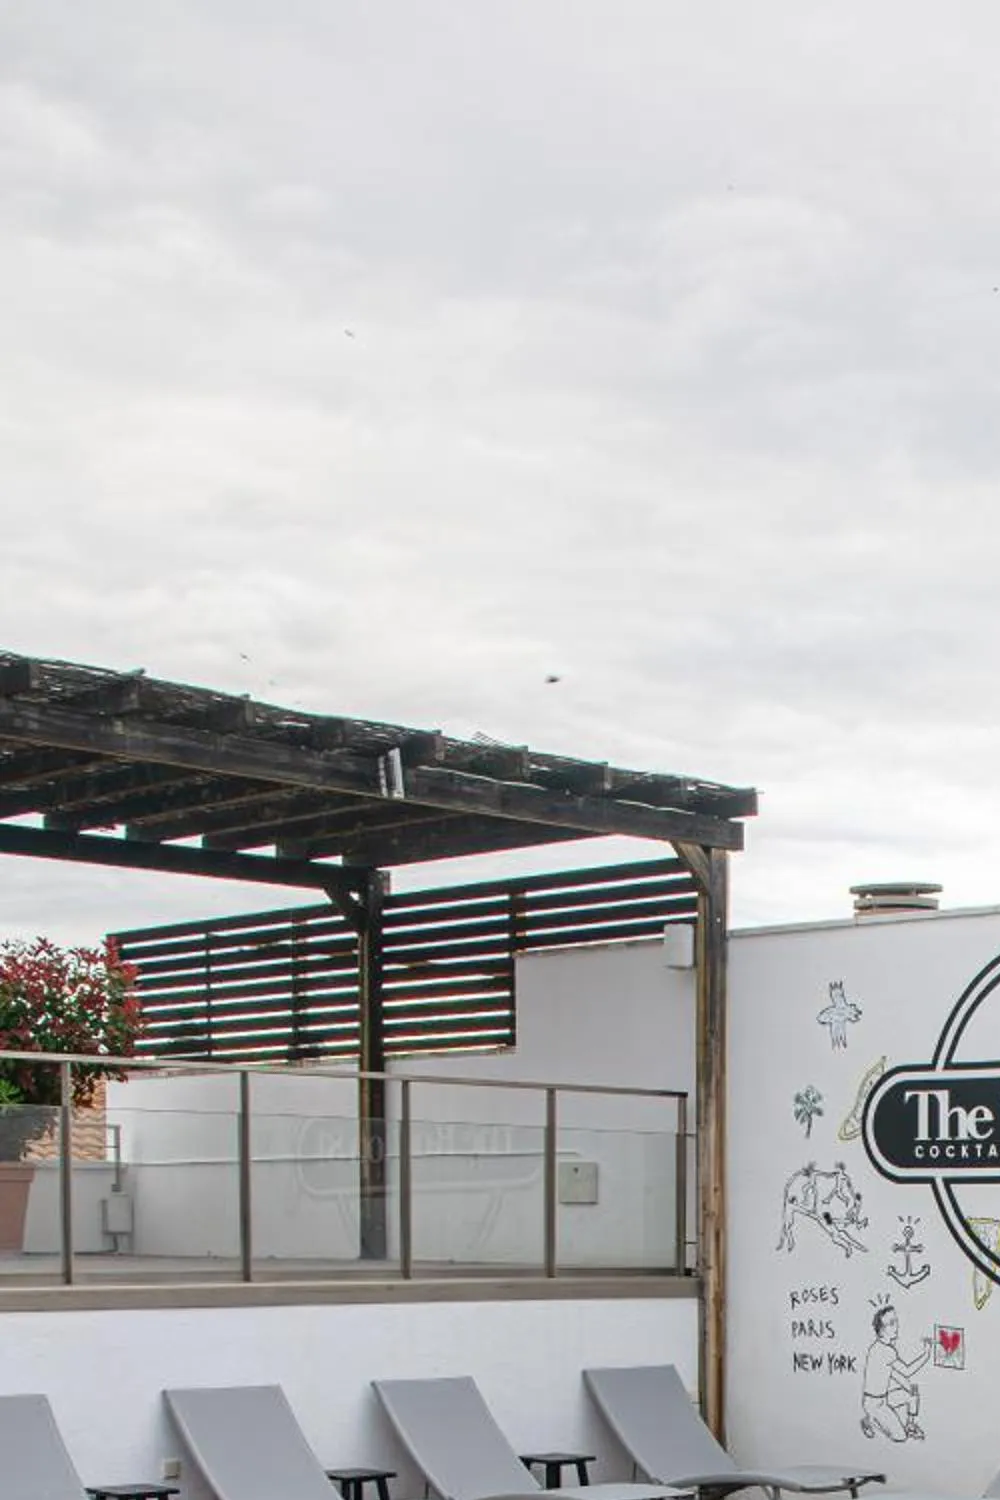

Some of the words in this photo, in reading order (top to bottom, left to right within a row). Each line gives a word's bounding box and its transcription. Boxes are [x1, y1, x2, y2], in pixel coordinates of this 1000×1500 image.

[905, 1089, 994, 1141] The
[789, 1287, 839, 1311] ROSES
[791, 1319, 835, 1339] PARIS
[793, 1352, 823, 1372] NEW
[827, 1353, 857, 1375] YORK
